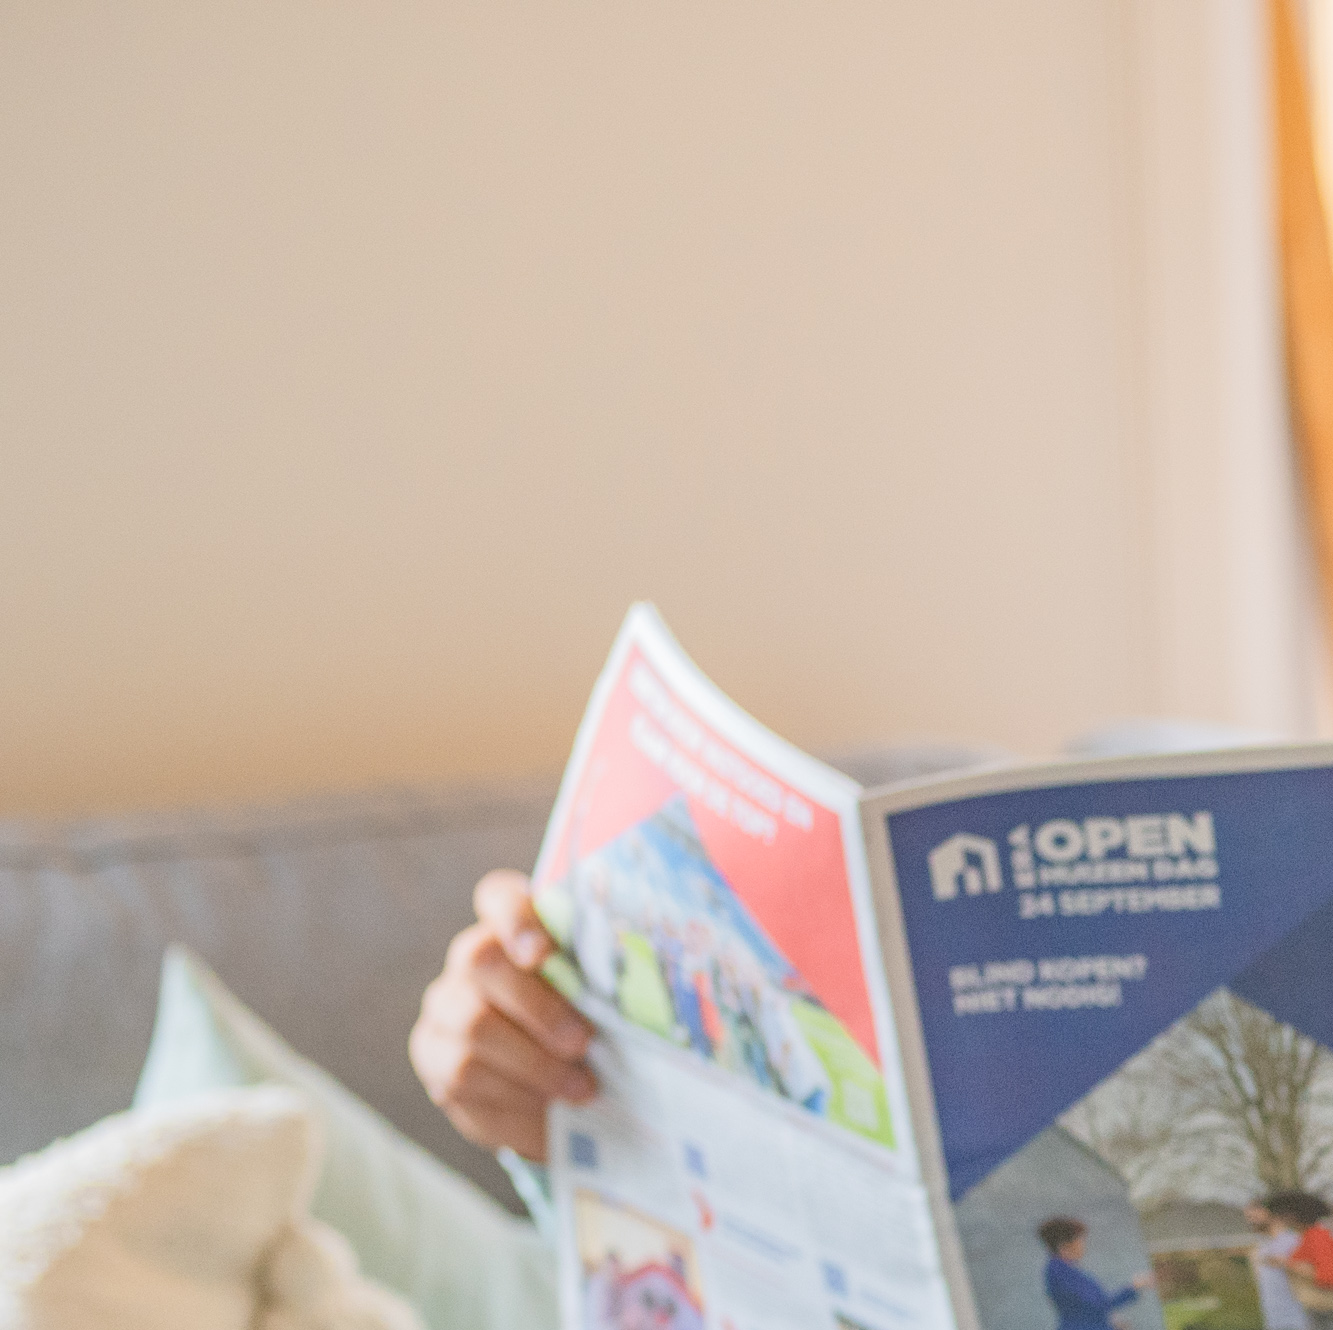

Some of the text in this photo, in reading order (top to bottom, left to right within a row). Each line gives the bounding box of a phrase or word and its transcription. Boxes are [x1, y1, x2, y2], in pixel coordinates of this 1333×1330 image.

[1035, 812, 1215, 863] OPEN
[1040, 858, 1219, 886] HUIZEN DAG
[1019, 885, 1221, 919] 24 SEPTEMBER
